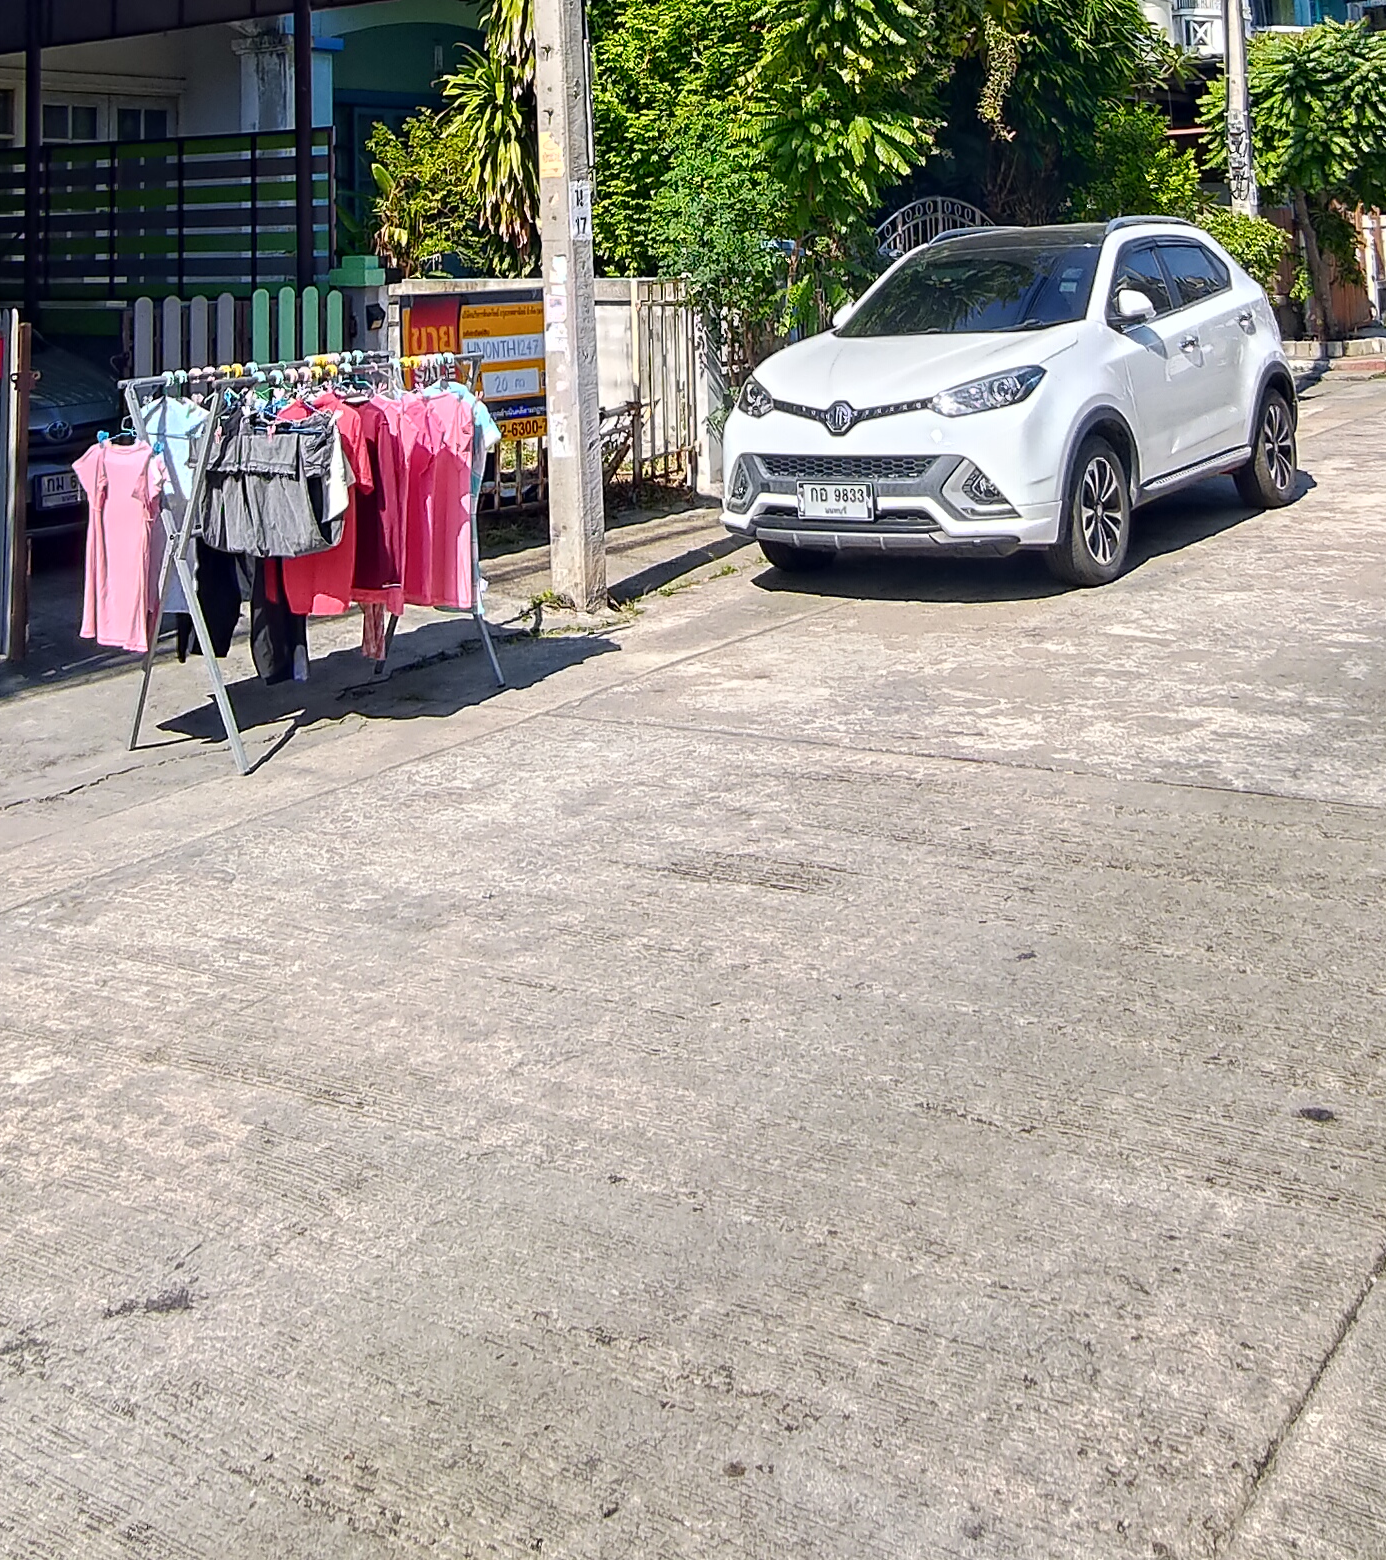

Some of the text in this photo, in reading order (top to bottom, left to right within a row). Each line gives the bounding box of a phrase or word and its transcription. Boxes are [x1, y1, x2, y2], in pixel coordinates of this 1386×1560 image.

[411, 325, 455, 354] ขาย
[414, 363, 456, 383] SALE
[834, 487, 865, 502] 9833
